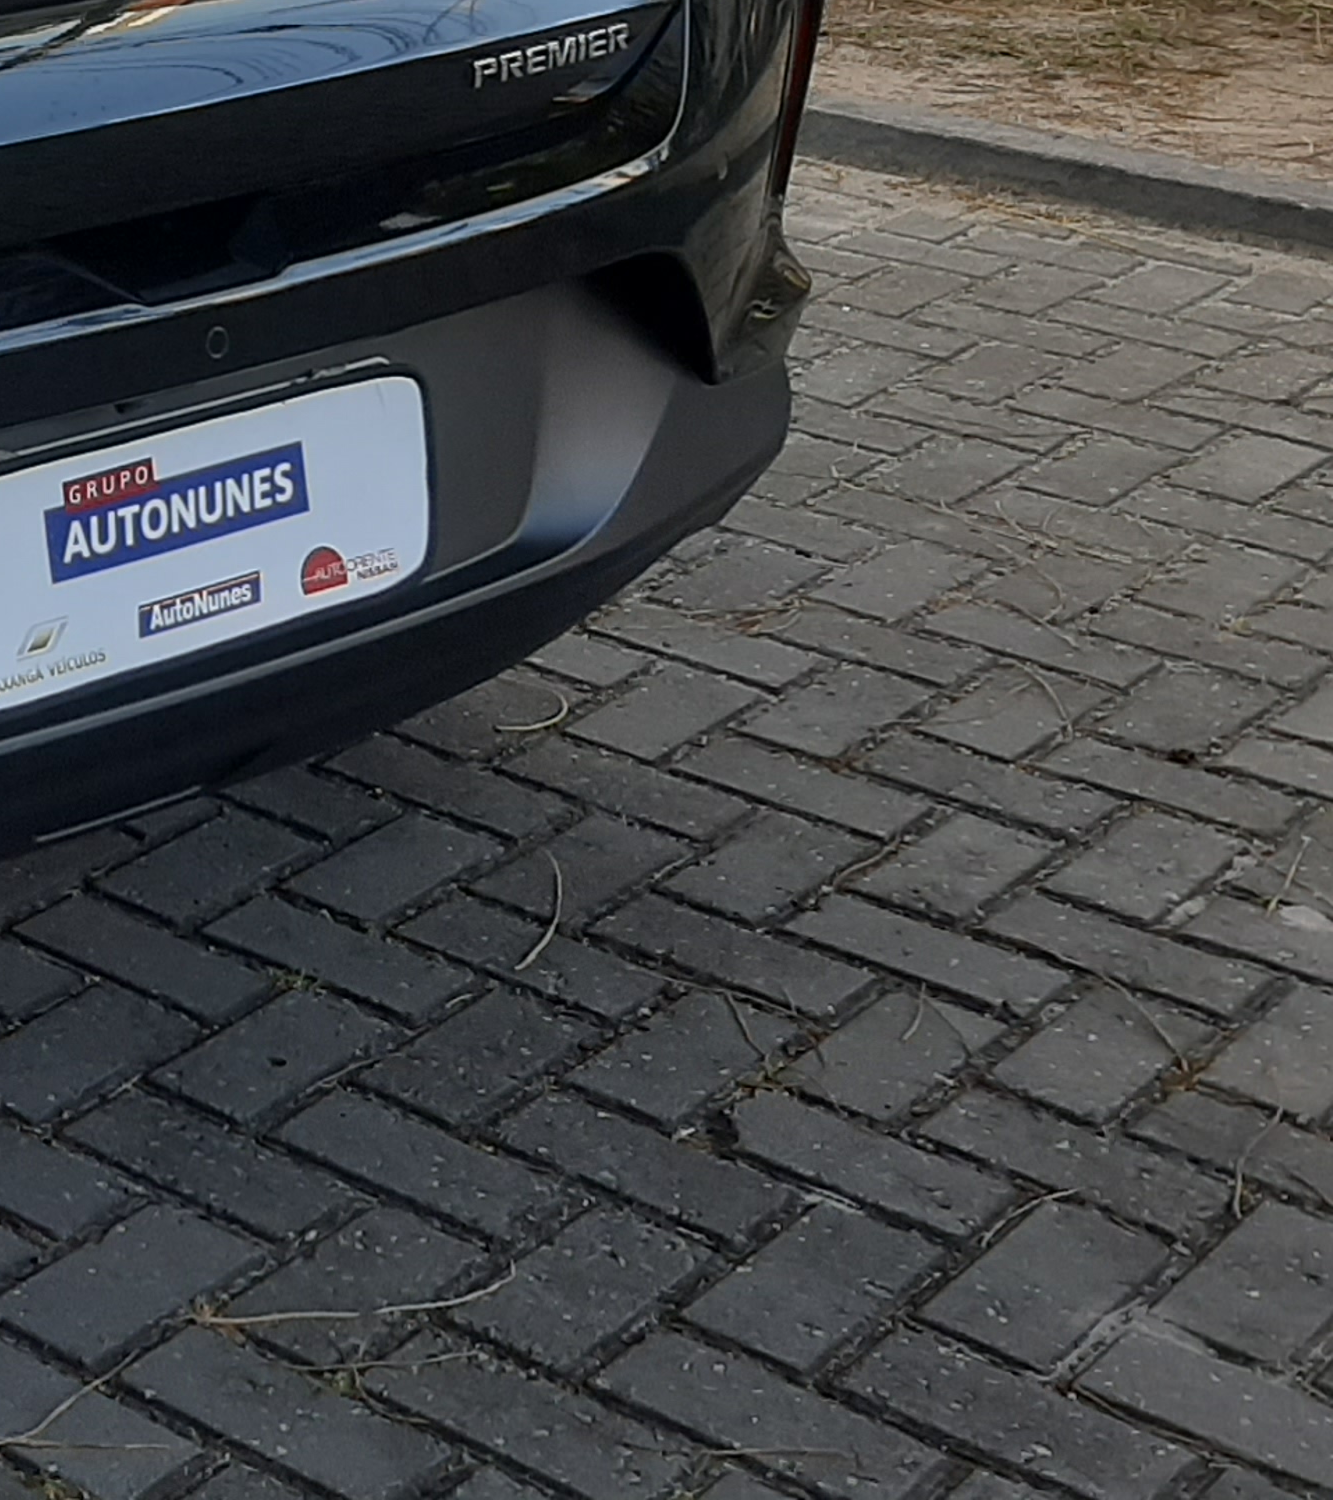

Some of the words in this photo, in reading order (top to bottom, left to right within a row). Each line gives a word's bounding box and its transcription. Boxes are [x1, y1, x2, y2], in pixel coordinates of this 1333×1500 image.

[473, 23, 629, 88] PREMIER
[63, 462, 293, 564] AUTONUNES
[68, 465, 149, 505] GRUPO
[150, 583, 252, 630] AutoNunes
